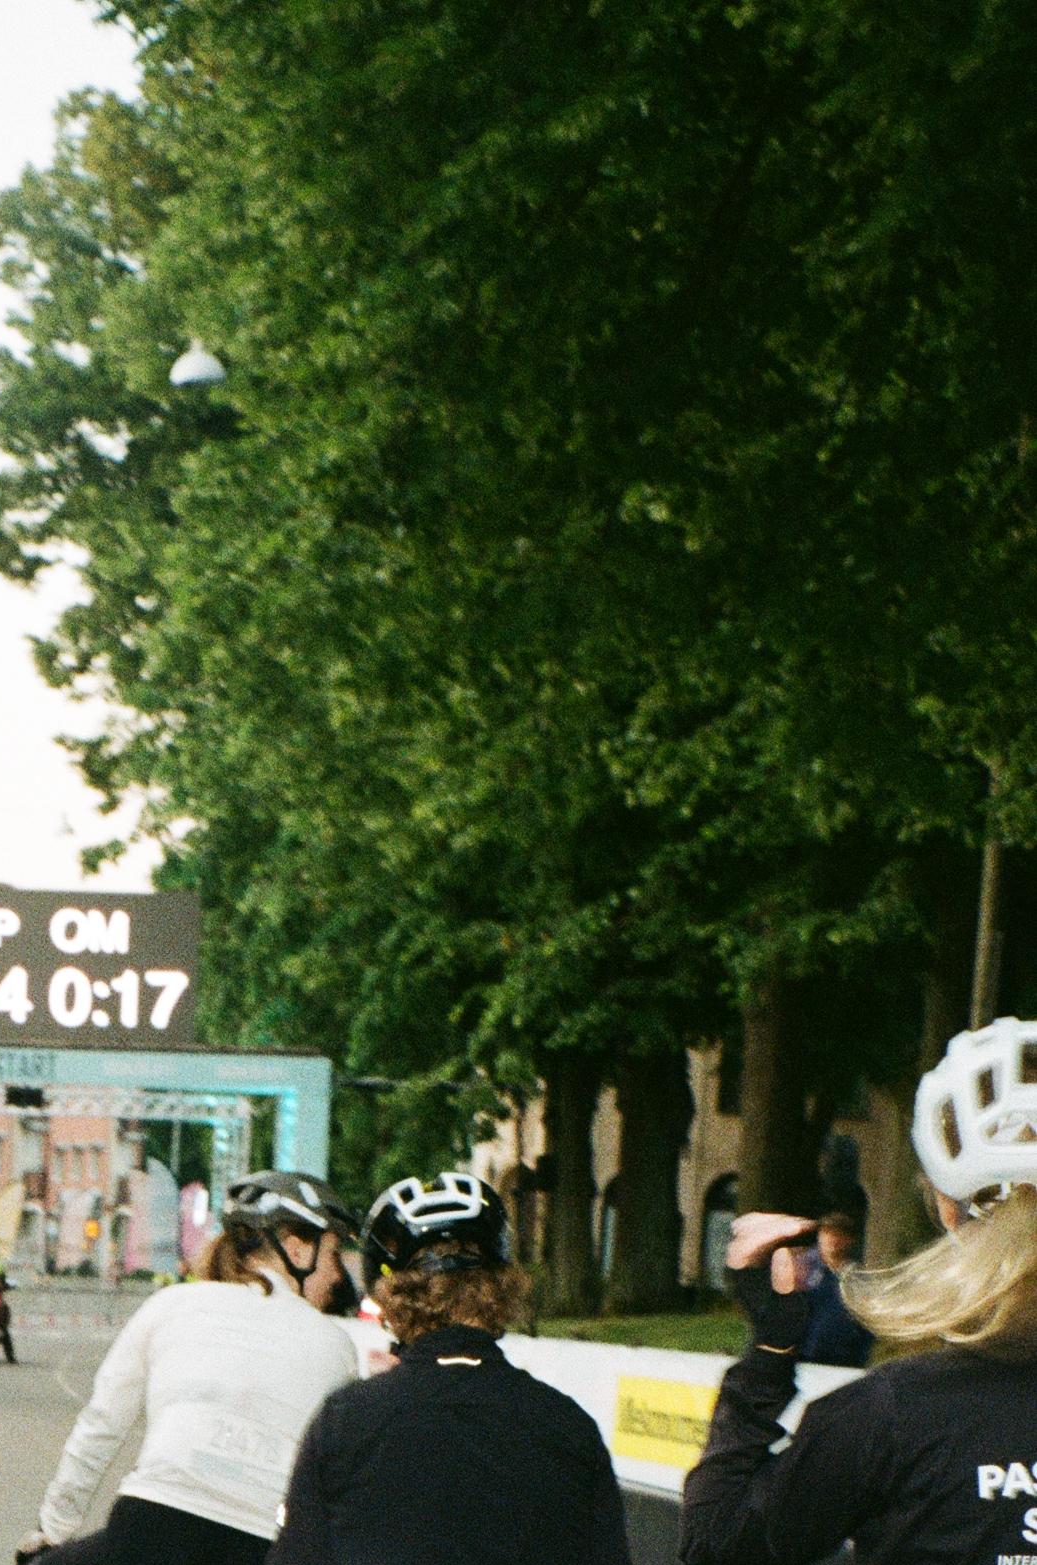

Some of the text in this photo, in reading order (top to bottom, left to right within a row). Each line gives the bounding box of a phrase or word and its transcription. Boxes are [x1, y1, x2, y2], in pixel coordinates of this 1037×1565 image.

[49, 907, 131, 954] OM
[48, 965, 190, 1030] 0:17
[977, 1462, 1037, 1500] PA
